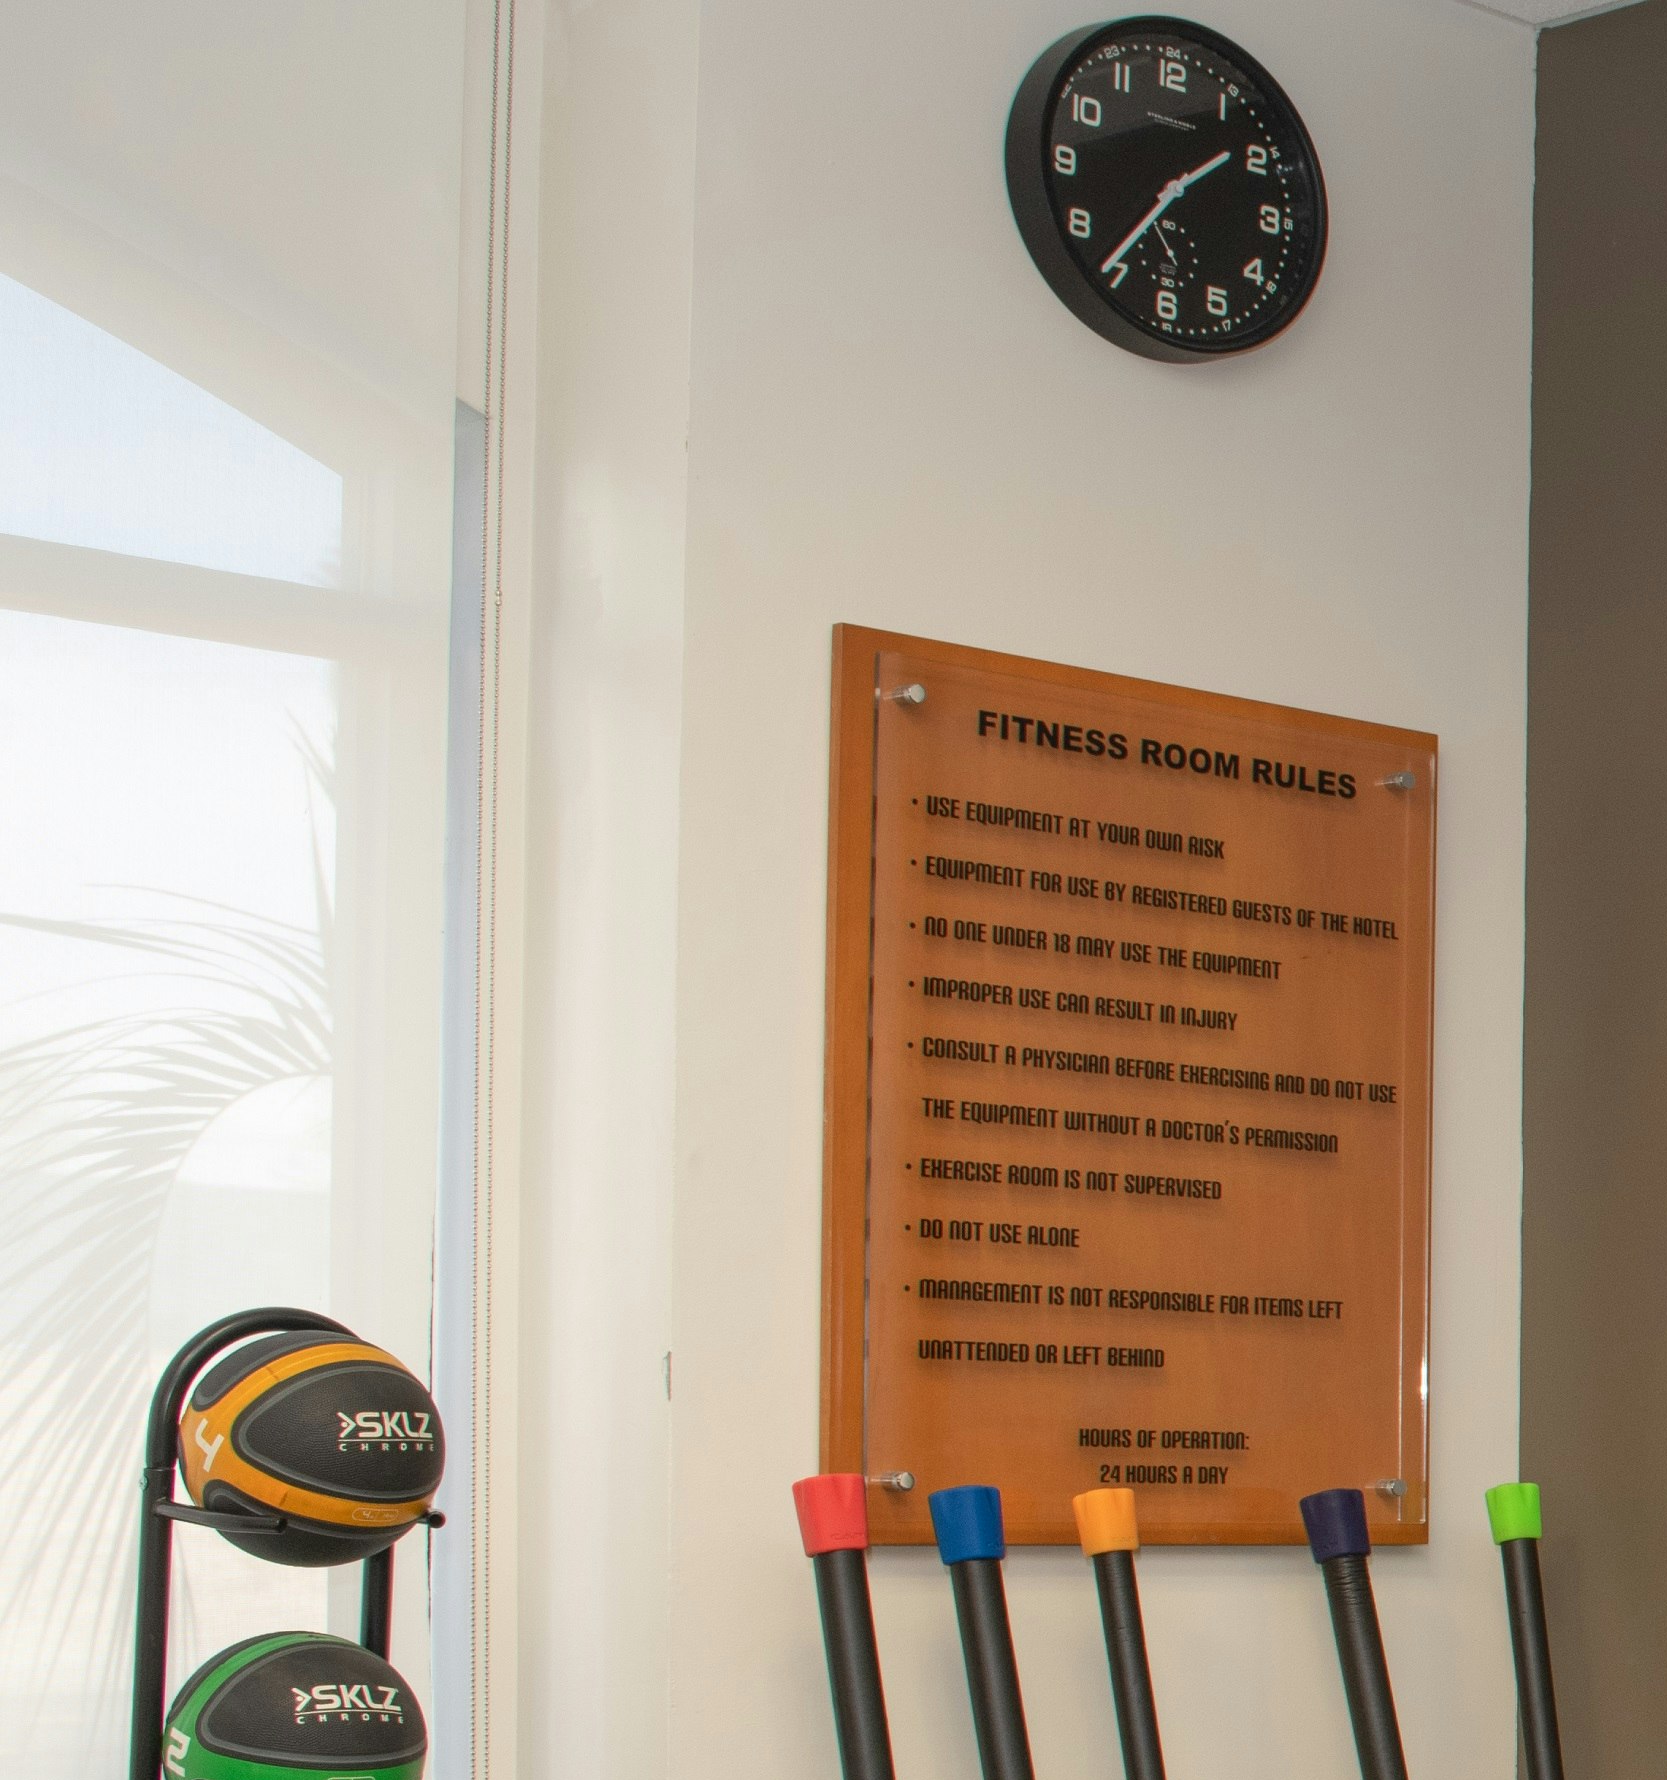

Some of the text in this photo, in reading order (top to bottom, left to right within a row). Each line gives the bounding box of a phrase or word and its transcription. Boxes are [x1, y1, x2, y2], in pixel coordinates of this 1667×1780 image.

[1104, 45, 1120, 59] 23
[1166, 46, 1180, 60] 24
[1115, 62, 1130, 93] 11
[1159, 58, 1187, 93] 12
[1073, 93, 1101, 127] 10
[1220, 92, 1226, 120] 1
[1055, 145, 1076, 176] 9
[1247, 144, 1267, 176] 2
[1069, 207, 1091, 239] 8
[1260, 205, 1280, 235] 3
[1110, 262, 1128, 288] 7
[1243, 258, 1264, 286] 4
[1157, 290, 1178, 320] 6
[1207, 286, 1228, 316] 5
[978, 710, 1356, 798] FITNESS ROOM RULES
[927, 796, 1224, 859] USE EQUIPMENT AT YOUR OWN RISK
[926, 856, 1398, 940] EQUIPMENT FOR USE BY REGISTERED GUESTS OF THE HOTEL
[925, 916, 1281, 979] NO ONE UNDER 18 MAY USE THE EQUIPMENT
[924, 977, 1237, 1030] IMPROPER USE CAN RESULT IN INJURY
[923, 1037, 1396, 1103] CONSULT A PHYSICIAN BEFORE EXERCISING AND DO NOT USE
[922, 1098, 954, 1119] THE
[961, 1101, 1058, 1128] EQUIPMENT
[1065, 1111, 1140, 1135] WITHOUT
[1146, 1118, 1155, 1137] A
[1246, 1127, 1338, 1153] PERMISSION
[921, 1158, 1222, 1200] EXERCISE ROOM IS NOT SUPERVISED
[920, 1219, 1080, 1248] DO NOT USE ALONE
[920, 1279, 1343, 1319] MANAGEMENT IS NOT RESPONSIBLE FOR ITEMS LEFT
[919, 1340, 1164, 1368] UNATTENDED OR LEFT BEHIND
[356, 1412, 433, 1438] SKLZ
[1079, 1428, 1249, 1450] HOURS OF OPERATION:
[1100, 1465, 1228, 1484] 24 HOURS A DAY
[311, 1684, 402, 1711] SKLZ
